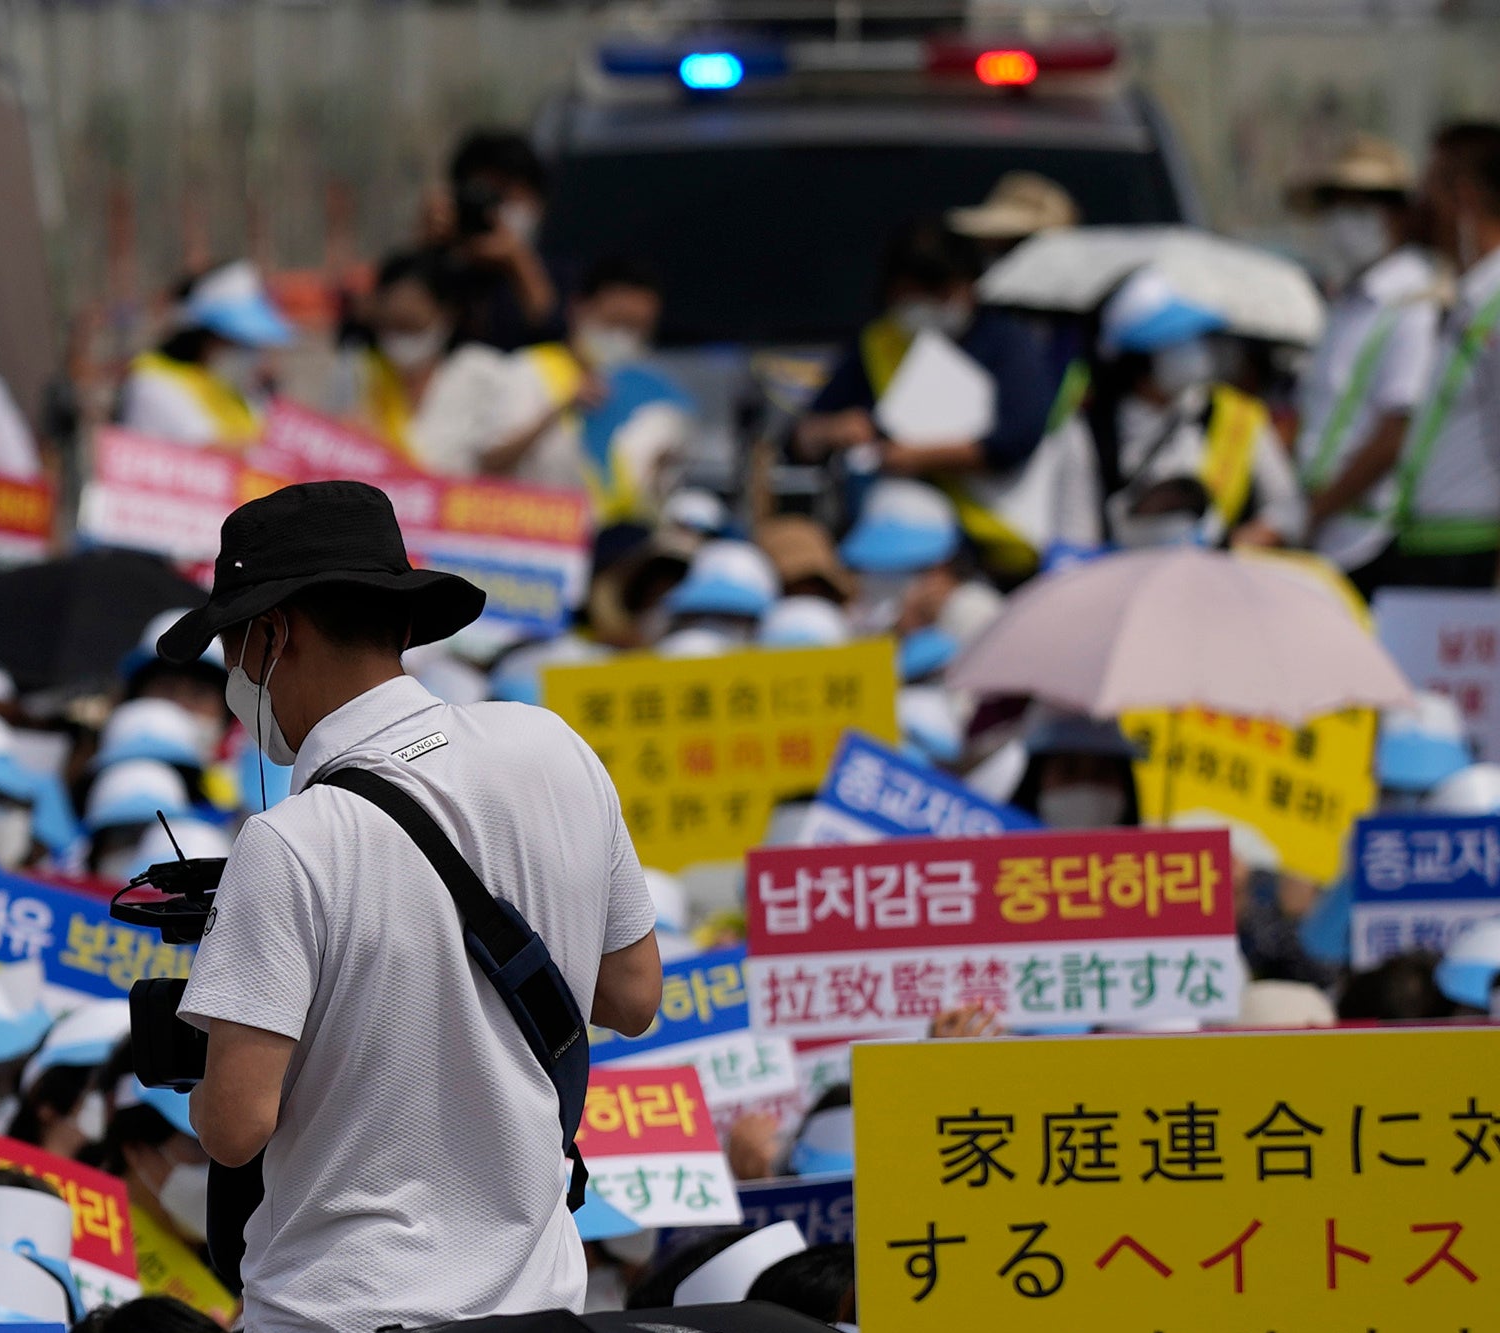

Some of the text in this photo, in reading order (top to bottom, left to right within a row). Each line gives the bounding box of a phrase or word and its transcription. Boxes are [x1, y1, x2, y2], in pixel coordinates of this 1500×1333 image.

[398, 733, 445, 760] W.ANGLE
[758, 849, 1222, 936] 납치감금 중단하라
[761, 949, 1226, 1028] 拉致監禁を許すな
[592, 1163, 722, 1214] すな
[885, 1217, 1480, 1303] するヘイトス
